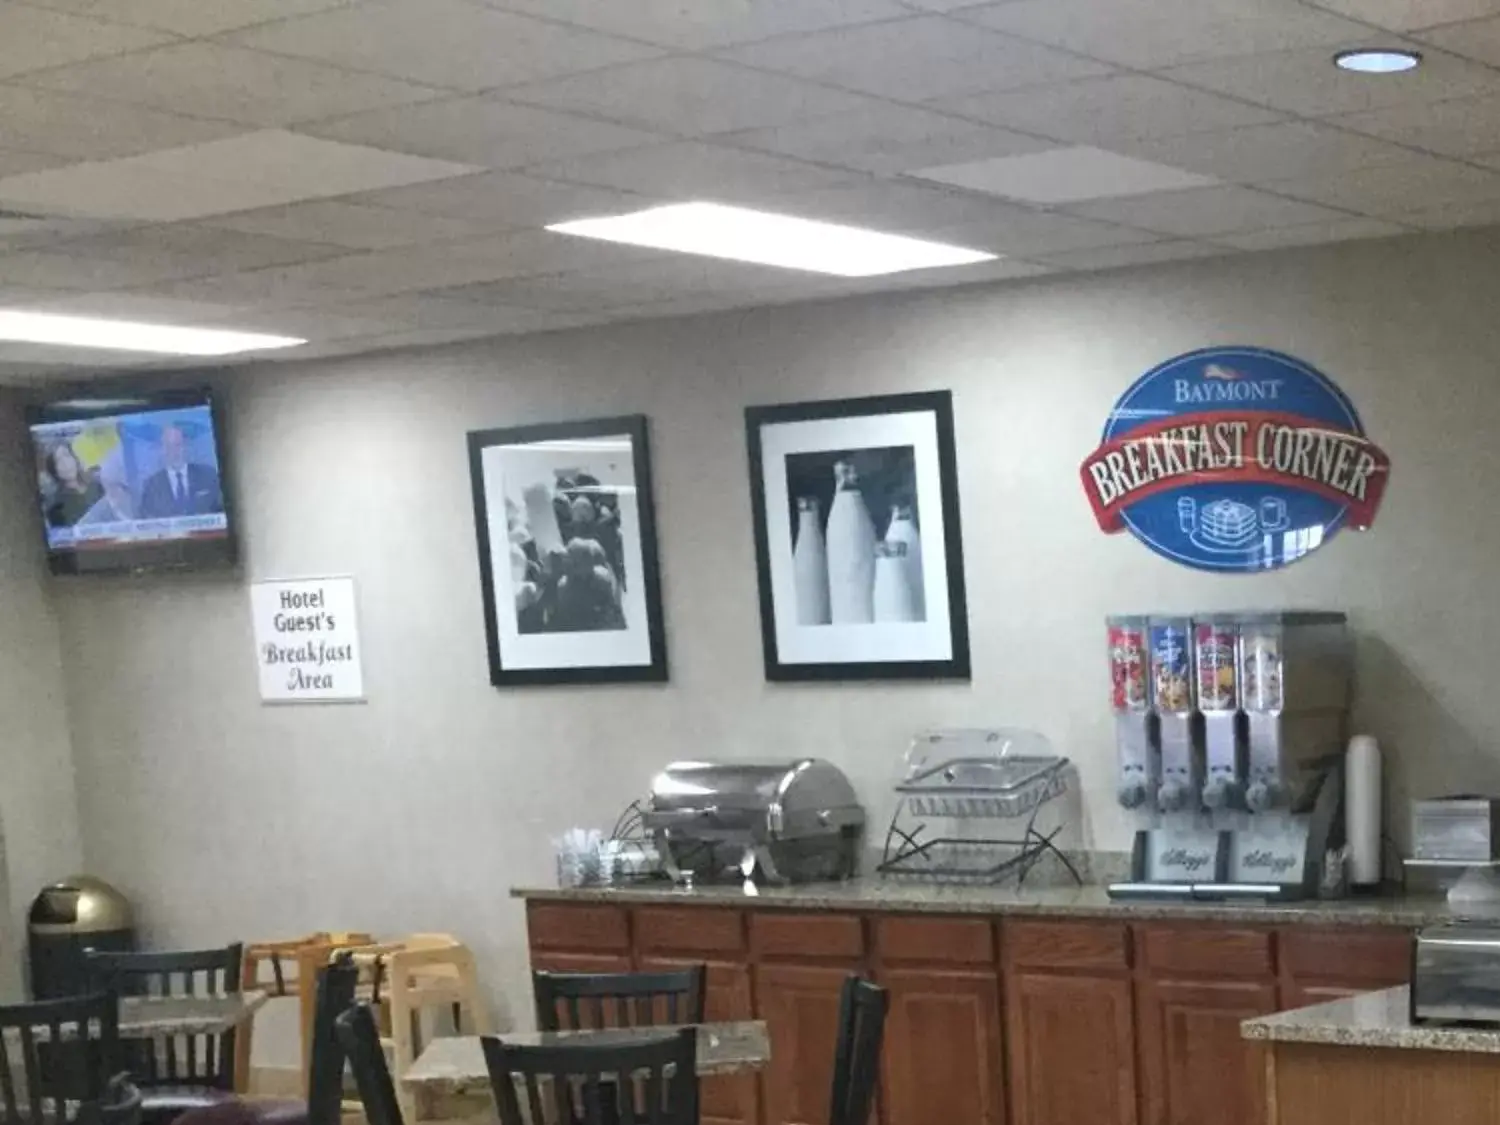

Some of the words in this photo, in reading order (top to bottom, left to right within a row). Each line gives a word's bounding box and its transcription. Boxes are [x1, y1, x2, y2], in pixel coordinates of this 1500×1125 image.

[1175, 379, 1284, 402] BAYMONT
[1089, 422, 1248, 506] BREAKFAST
[1257, 423, 1374, 502] CORNER
[280, 588, 325, 609] Hotel
[274, 611, 336, 632] Guest's
[262, 640, 352, 666] Breakfast
[287, 667, 333, 690] Area
